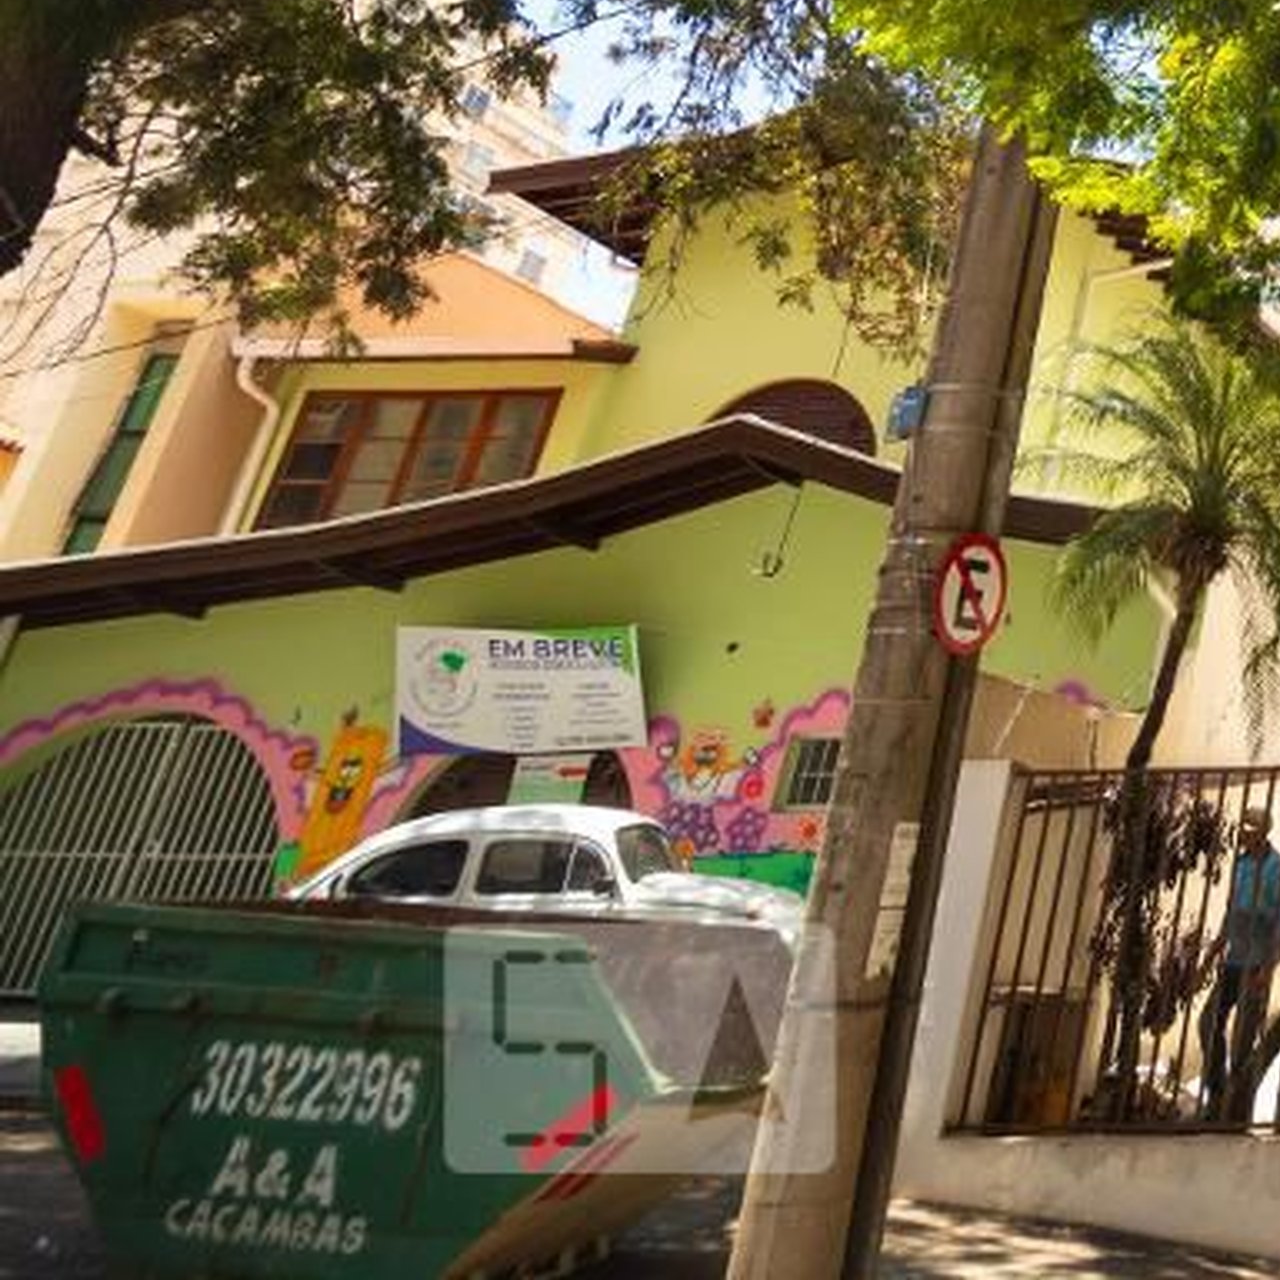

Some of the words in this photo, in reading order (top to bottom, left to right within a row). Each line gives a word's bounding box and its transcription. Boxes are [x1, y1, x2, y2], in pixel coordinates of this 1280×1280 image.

[488, 639, 525, 658] EM
[532, 637, 624, 659] BREVE
[191, 1038, 421, 1131] 30322996
